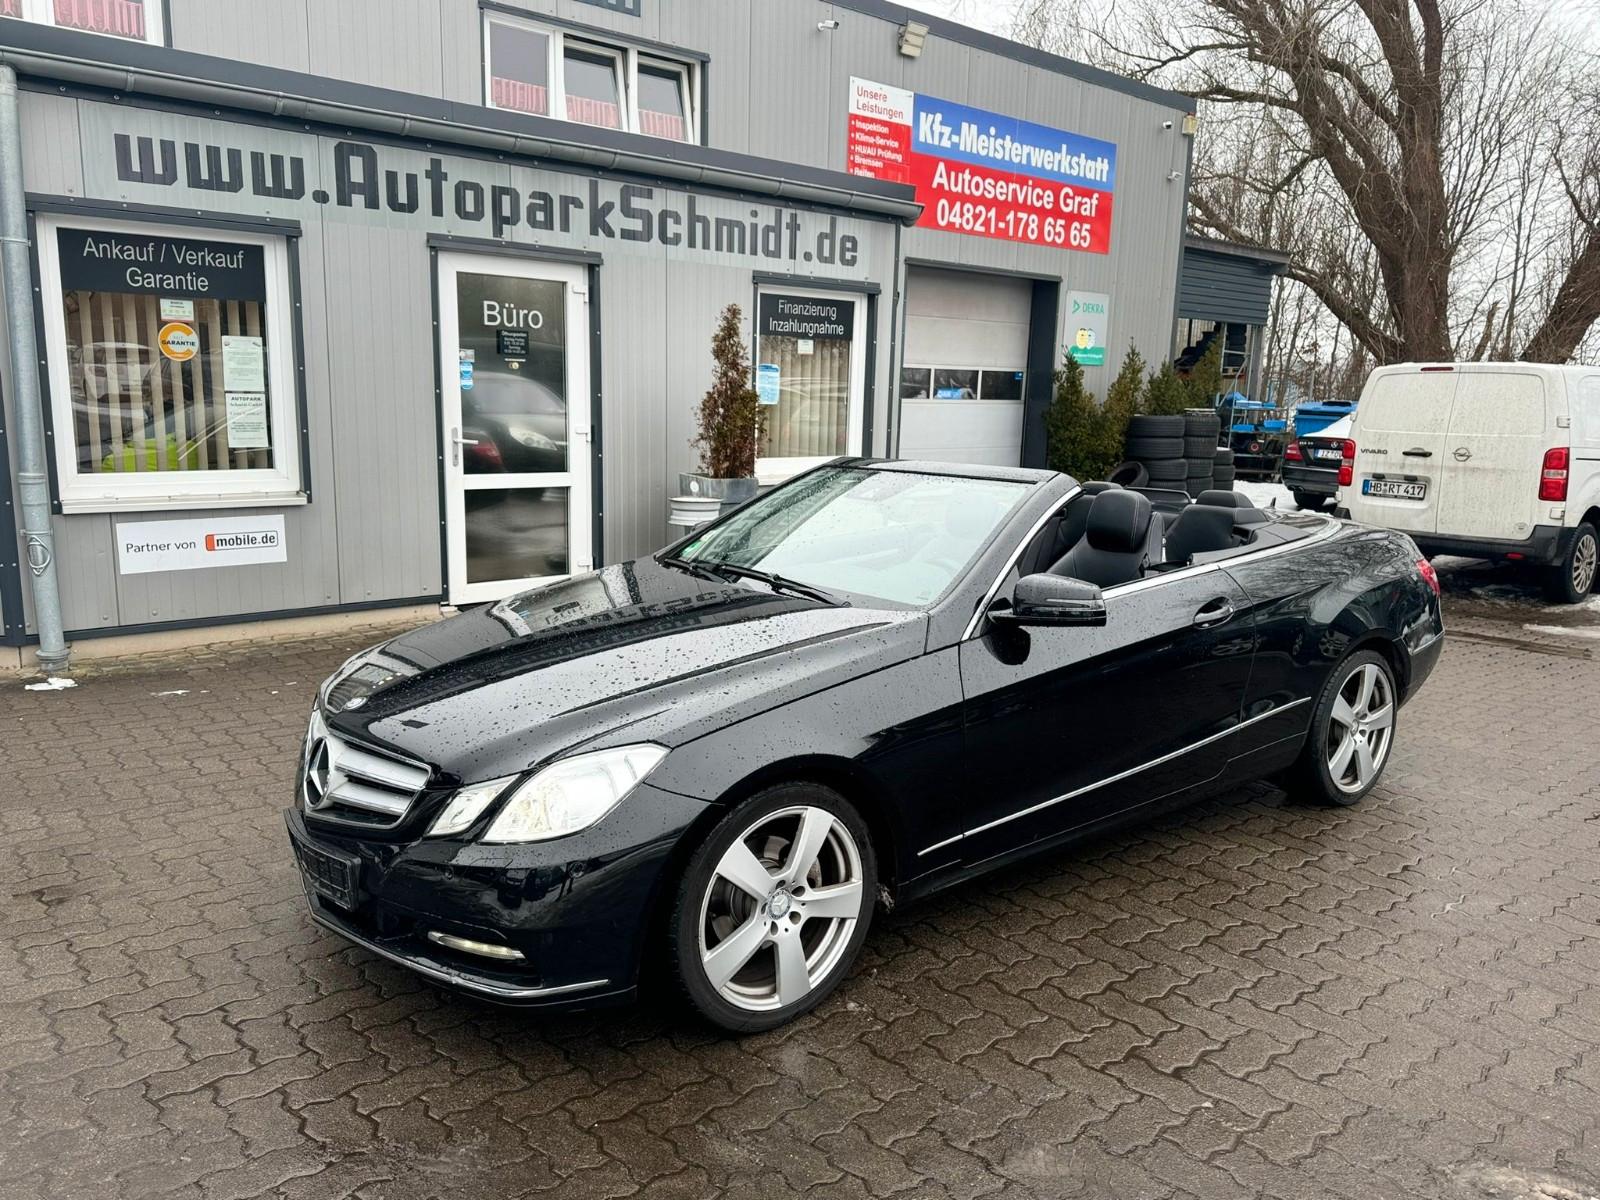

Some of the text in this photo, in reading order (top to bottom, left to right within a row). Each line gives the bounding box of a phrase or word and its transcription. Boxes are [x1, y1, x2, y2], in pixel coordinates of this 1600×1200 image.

[857, 86, 887, 101] Unsere
[856, 100, 903, 119] Leistungen
[855, 119, 889, 134] Inspektion
[855, 132, 899, 148] Klima-Service
[918, 111, 1109, 182] Kfz-Meisterwerkstatt
[854, 144, 903, 163] HU/AU Prüfung
[854, 155, 883, 168] Bremsen
[931, 161, 1099, 218] Autoservice Graf
[114, 133, 859, 267] www.AutoparkSchmidt.de
[936, 198, 1092, 249] 04821-178 65 65
[83, 237, 245, 270] Ankauf / Verkauf
[126, 267, 210, 292] Garantie
[483, 300, 543, 329] Büro
[778, 299, 837, 320] Finanzierung
[1082, 302, 1105, 314] DEKRA
[769, 317, 845, 337] Inzahlungnahme
[1369, 482, 1424, 496] HB RT 417
[126, 533, 276, 553] Partner von mobile.de
